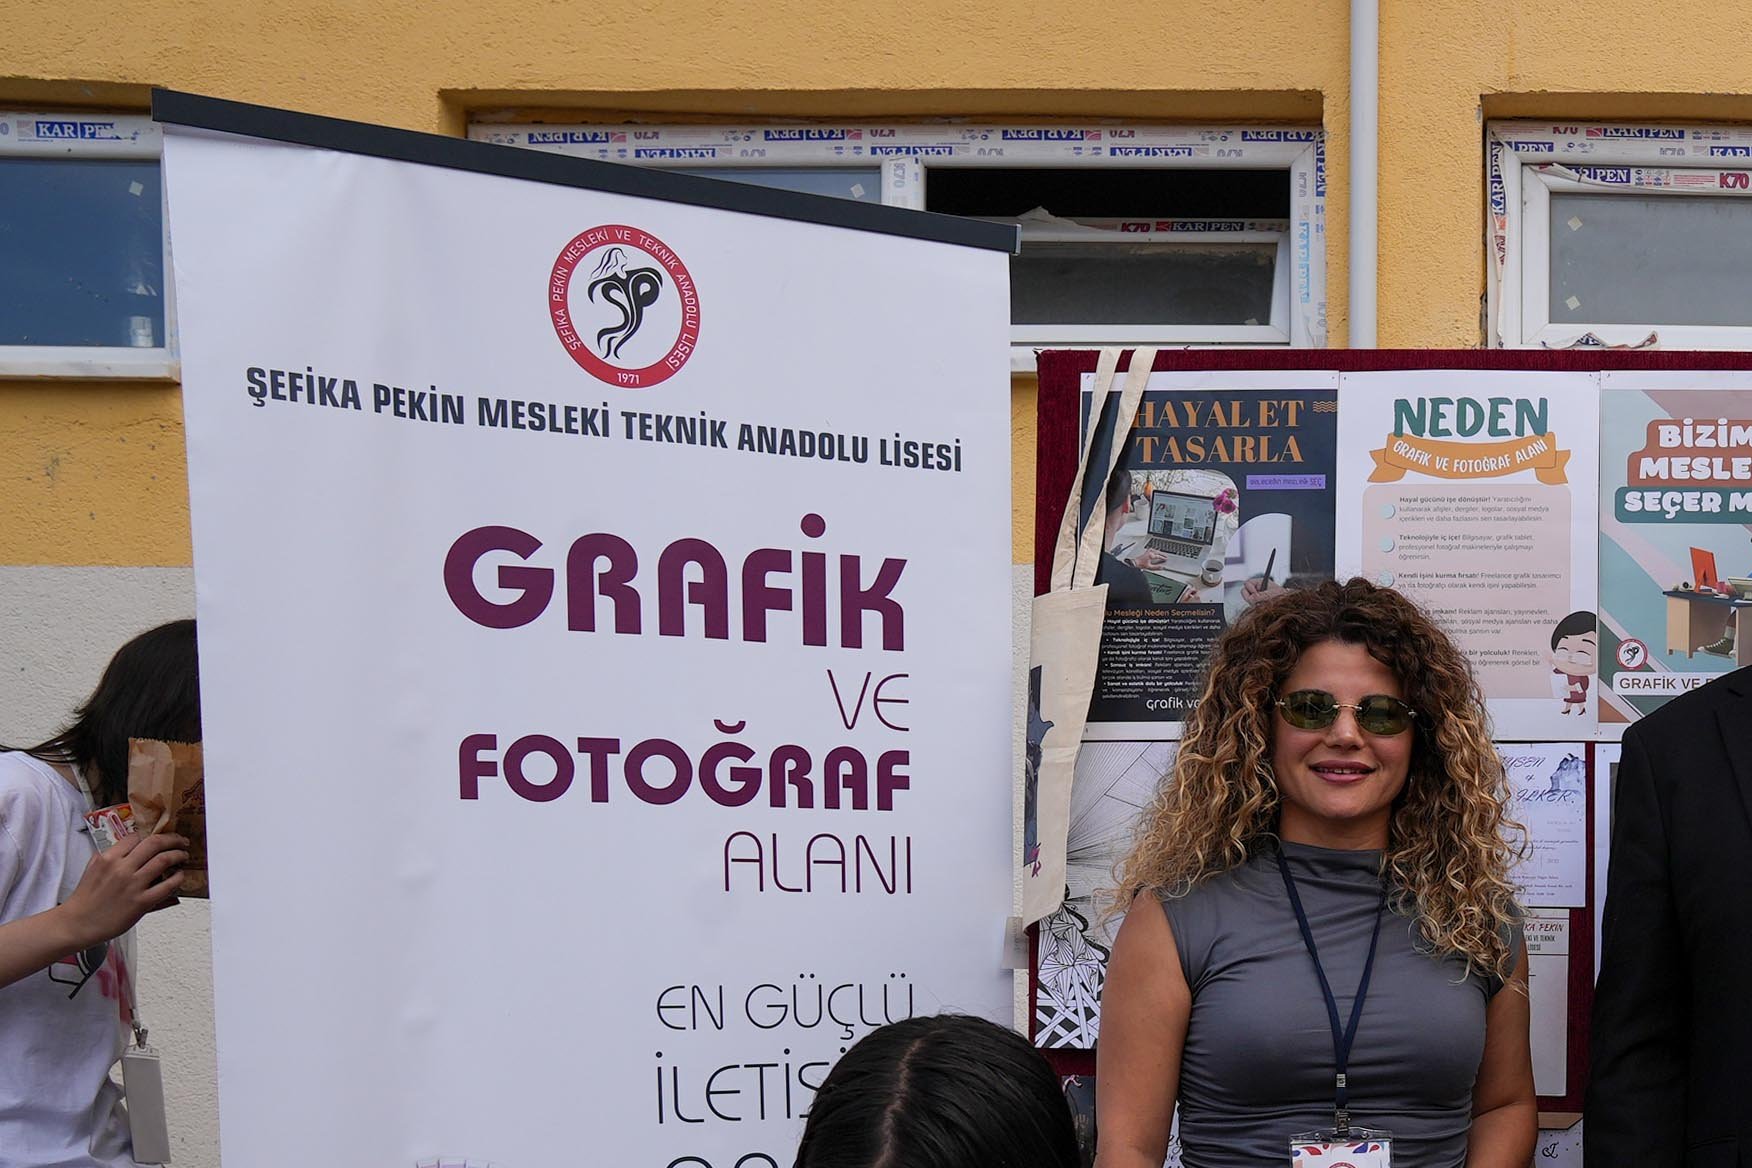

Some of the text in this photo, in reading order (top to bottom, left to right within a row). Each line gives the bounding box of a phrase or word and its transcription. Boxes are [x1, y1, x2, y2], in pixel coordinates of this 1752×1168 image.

[36, 122, 78, 139] KAR
[1595, 168, 1631, 183] PEN
[1719, 172, 1750, 189] K70
[1120, 221, 1243, 233] K70 KAR PEN
[552, 228, 697, 372] ŞEFİKA PEKİN MESLEKİ VE TEKNİK ANADOLU LİSESİ
[617, 372, 641, 385] 1971
[246, 366, 963, 473] ŞEFİKA PEKİN MESLEKİ TEKNİK ANADOLU LİSESİ
[1133, 399, 1305, 429] HAYAL ET
[1394, 397, 1548, 438] NEDEN
[1135, 434, 1305, 464] TASARLA
[1393, 439, 1549, 474] GRAFİK VE FOTOĞRAF ALANI
[1624, 491, 1722, 519] SEÇER
[443, 512, 908, 652] GRAFİK
[1619, 676, 1700, 690] GRAFİK VE
[827, 668, 910, 732] VE
[1146, 697, 1184, 712] grafik
[458, 718, 911, 812] FOTOĞRAF
[723, 830, 913, 895] ALANI
[656, 972, 914, 1041] EN GÜÇLÜ
